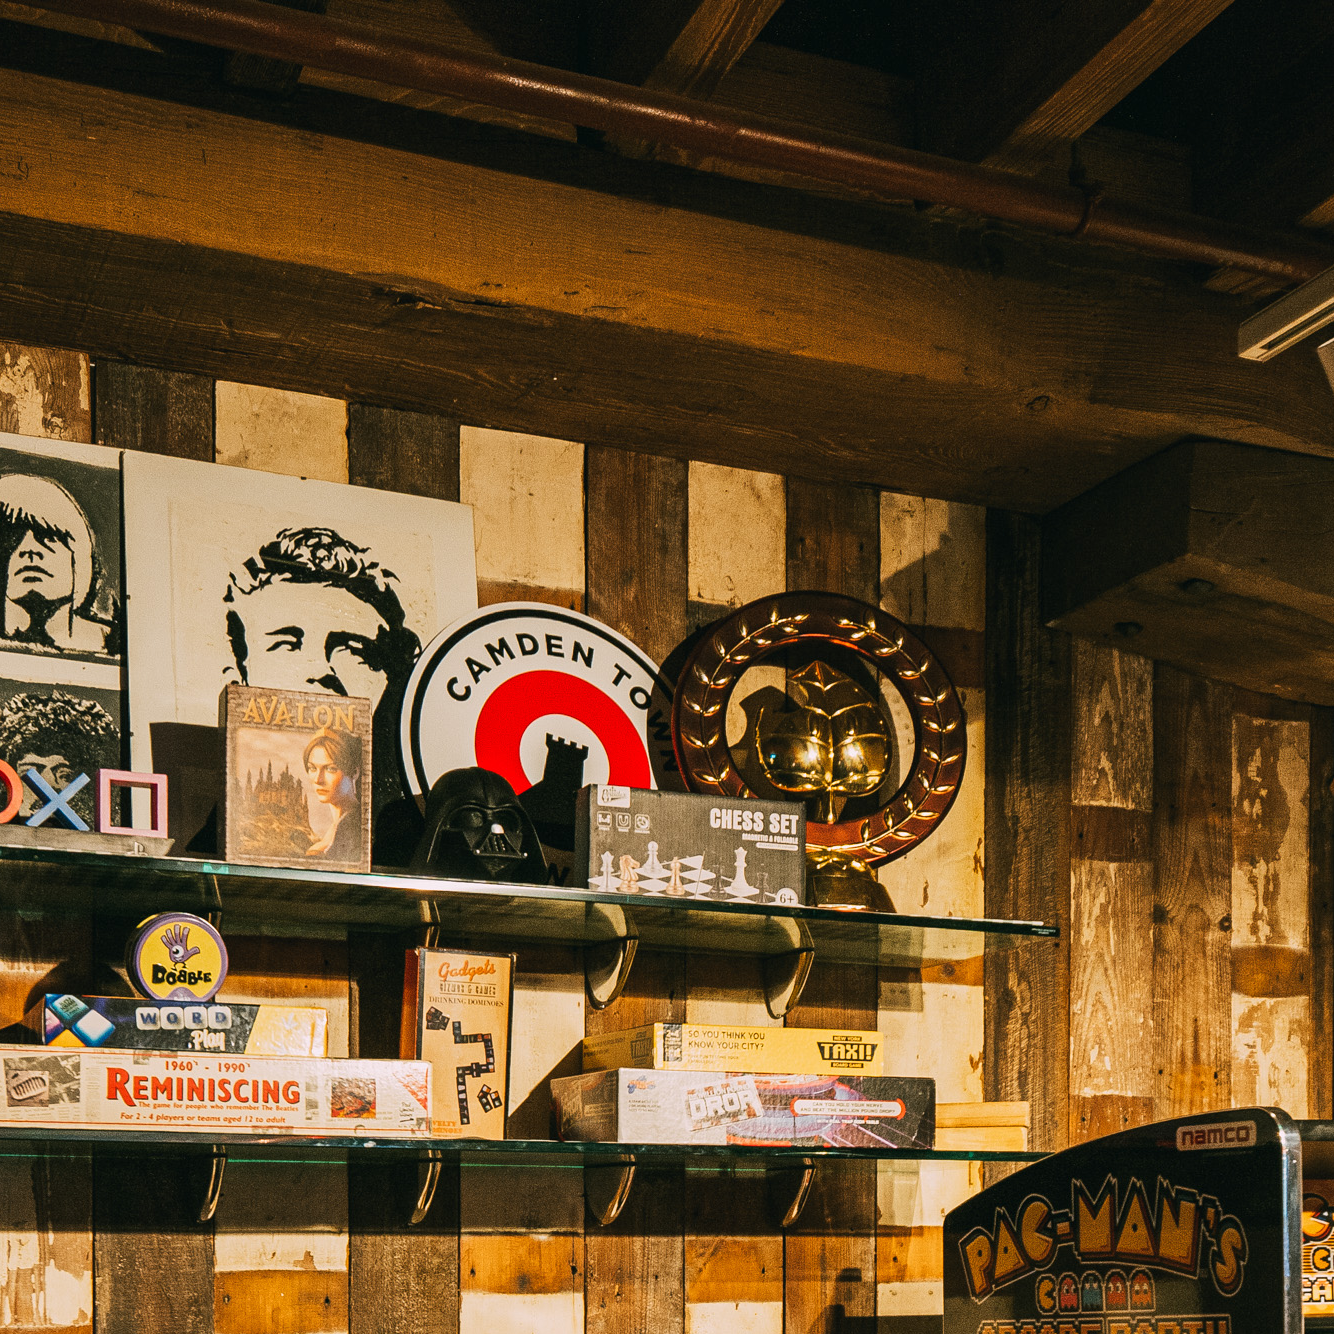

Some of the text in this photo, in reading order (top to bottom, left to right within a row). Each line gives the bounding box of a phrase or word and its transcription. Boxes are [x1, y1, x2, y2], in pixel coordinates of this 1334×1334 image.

[446, 633, 595, 702] CAMDEN
[242, 695, 357, 732] AVALON
[710, 808, 799, 835] CHESS SET
[779, 894, 795, 905] 6+
[437, 958, 497, 982] Gadgets
[428, 996, 504, 1007] DRINKING DOMINOES
[138, 1009, 229, 1028] WORD
[190, 1029, 226, 1051] Play
[688, 1030, 765, 1040] SO YOU THINK YOU
[688, 1041, 714, 1049] KNOW
[741, 1042, 765, 1051] CITY?
[820, 1042, 872, 1060] TAXI!
[106, 1067, 300, 1107] REMINISCING
[185, 1103, 207, 1111] people
[226, 1103, 259, 1111] remember
[276, 1104, 299, 1112] Beatles
[120, 1112, 134, 1120] For
[156, 1113, 185, 1122] players
[197, 1114, 221, 1122] teams
[223, 1115, 242, 1124] aged
[244, 1115, 253, 1123] 12
[266, 1116, 286, 1124] adult
[1181, 1125, 1251, 1145] namco
[961, 1177, 1247, 1300] PAC-MAN'S
